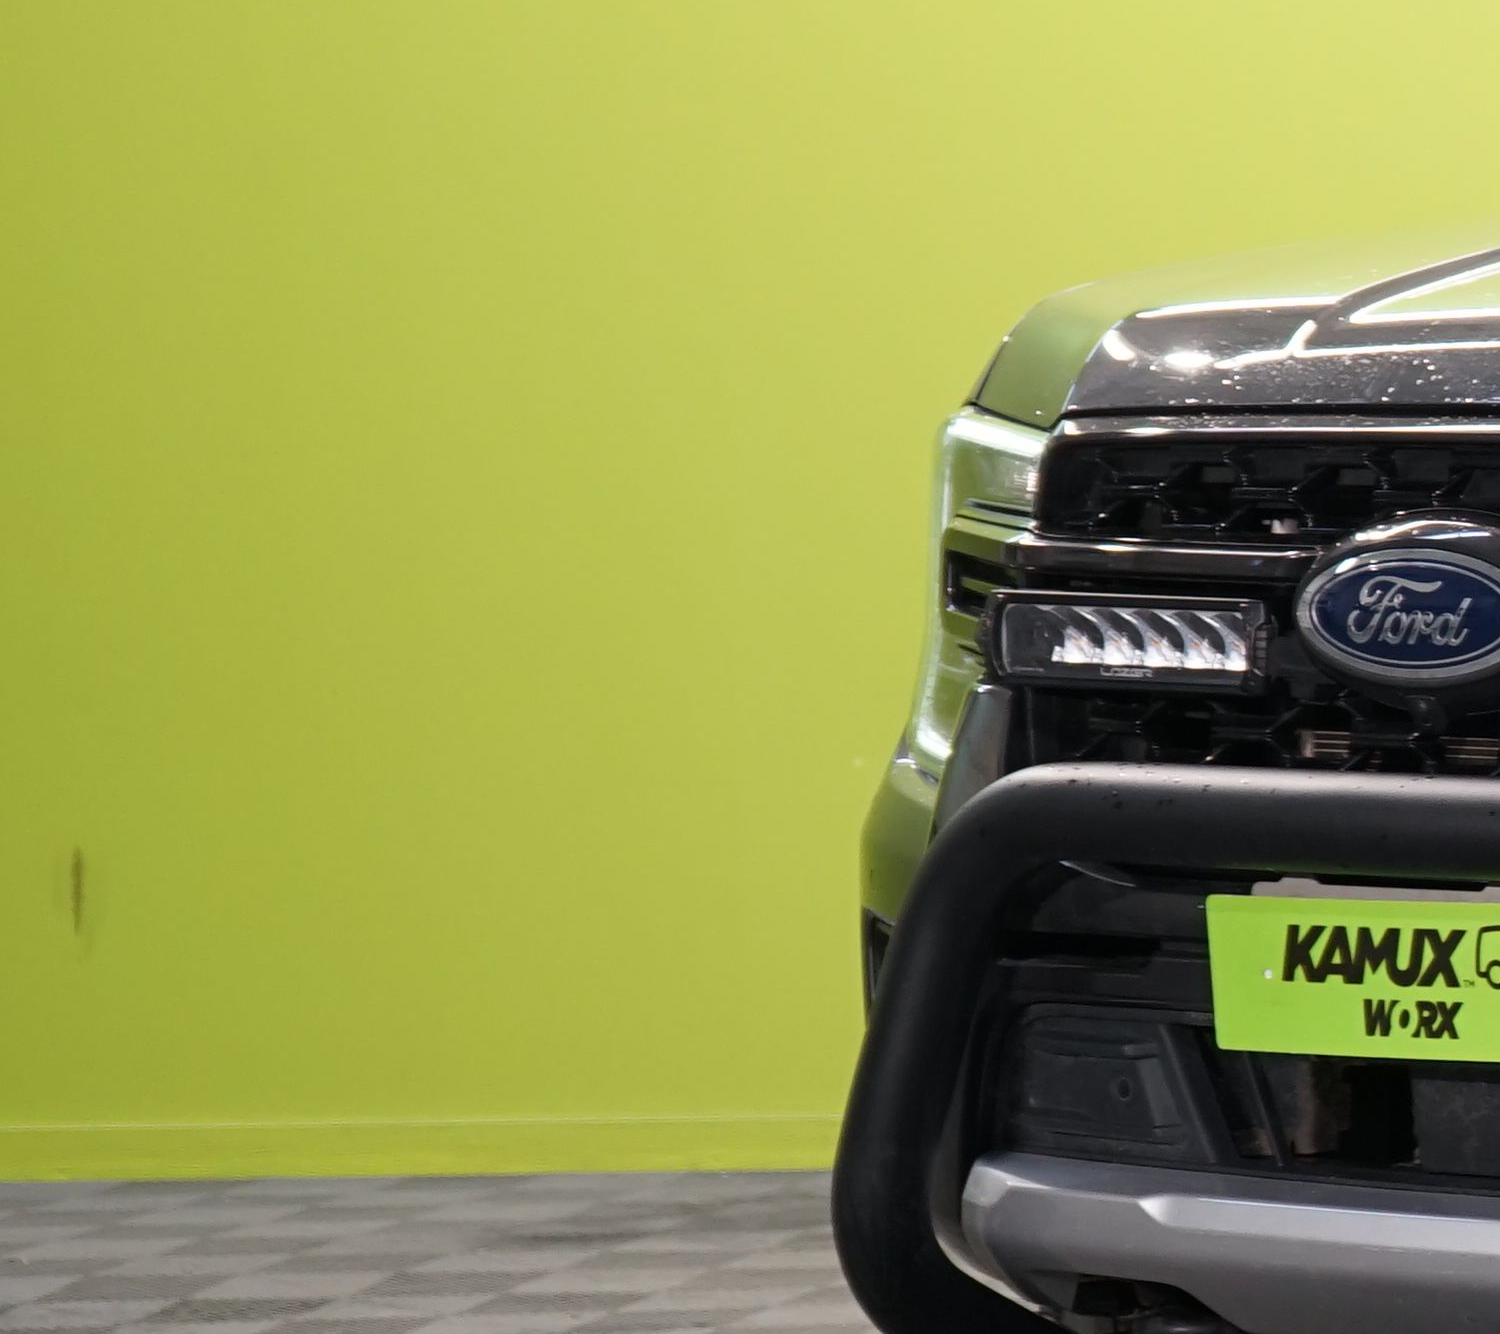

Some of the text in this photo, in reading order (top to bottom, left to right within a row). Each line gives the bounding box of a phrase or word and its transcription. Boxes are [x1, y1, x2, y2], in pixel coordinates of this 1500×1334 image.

[1347, 575, 1473, 647] Ford
[1281, 923, 1468, 989] KAMUX
[1363, 998, 1465, 1040] WORX
